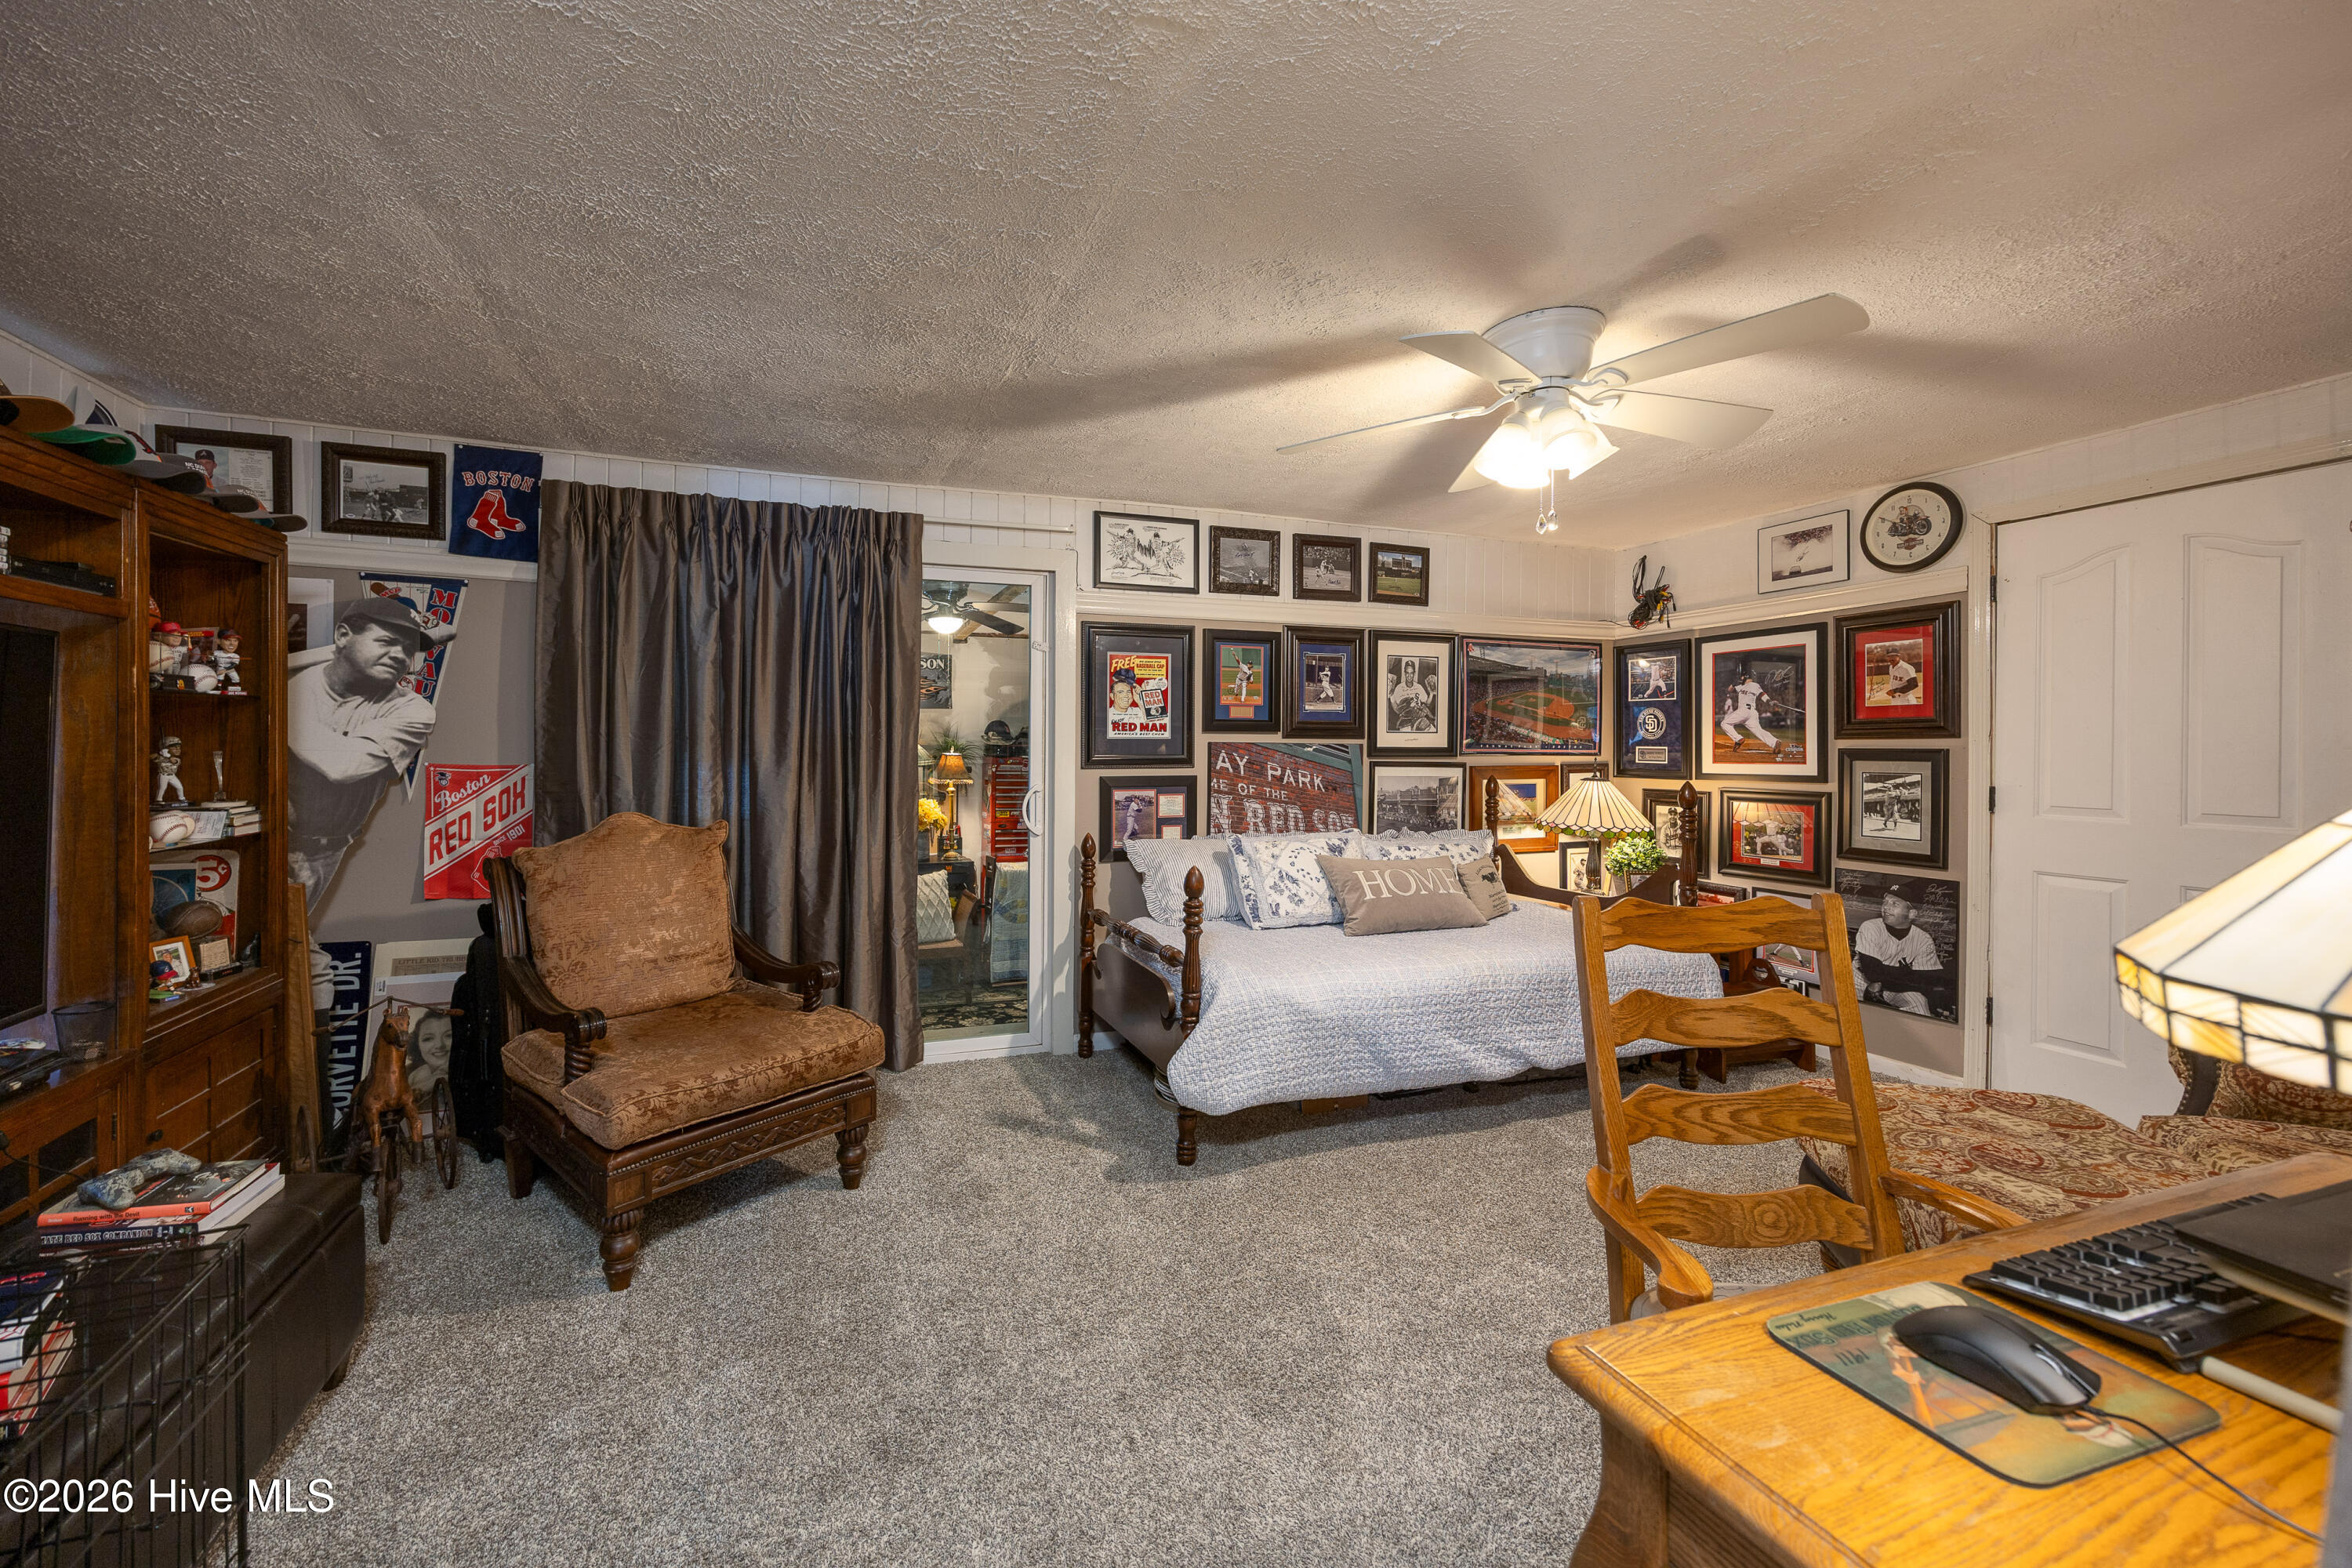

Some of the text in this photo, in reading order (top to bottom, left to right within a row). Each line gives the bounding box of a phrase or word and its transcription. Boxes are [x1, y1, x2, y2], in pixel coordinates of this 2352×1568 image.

[461, 470, 535, 492] BOSTON
[1111, 655, 1137, 672] FREE
[1145, 691, 1160, 699] RED
[1145, 699, 1163, 707] MAN
[1112, 723, 1167, 732] RED MAN
[1645, 715, 1657, 732] SD
[1267, 762, 1326, 793] PARK
[434, 774, 491, 811] Boston
[1238, 783, 1257, 796] OF
[1264, 787, 1289, 801] THE
[430, 774, 528, 866] RED SOX
[1243, 799, 1305, 833] RED
[506, 824, 526, 841] 1901
[1352, 867, 1465, 901] HOME
[328, 953, 362, 1112] ORVETTE DR.
[64, 1235, 82, 1243] RED
[85, 1232, 101, 1241] SOX
[103, 1229, 153, 1240] COMPANION
[1786, 1330, 1838, 1349] SOX
[1835, 1348, 1870, 1367] 1911
